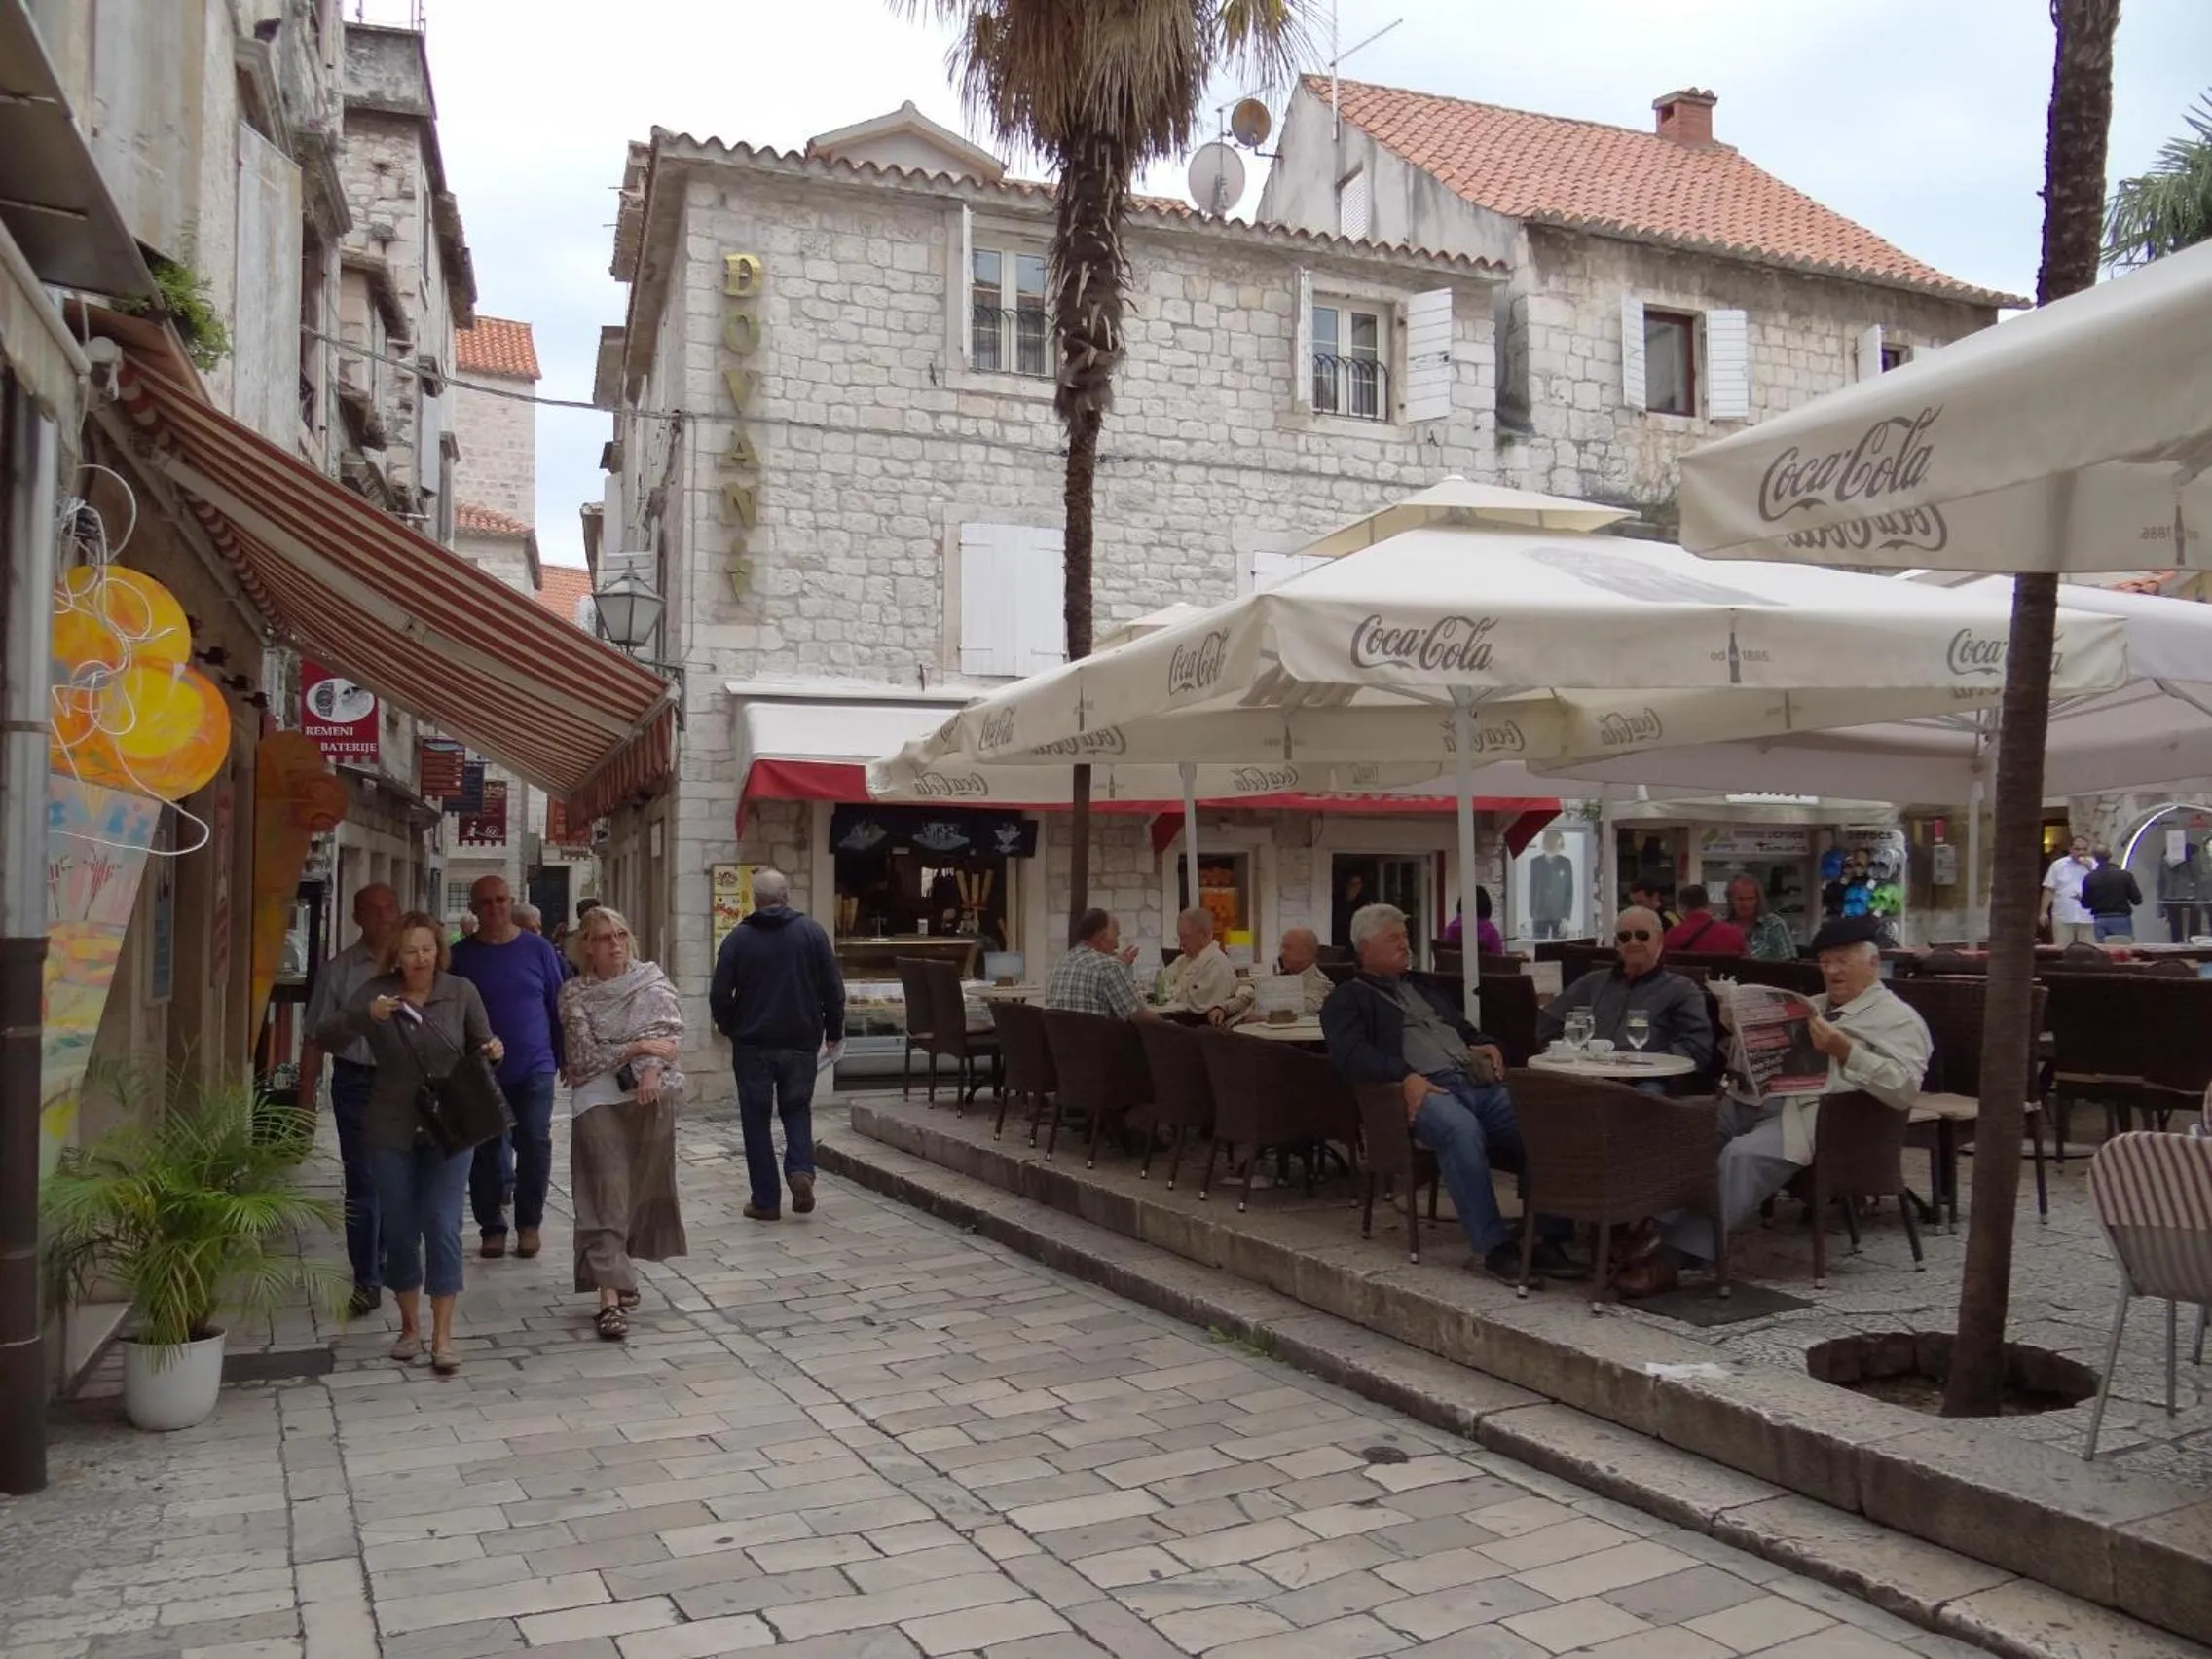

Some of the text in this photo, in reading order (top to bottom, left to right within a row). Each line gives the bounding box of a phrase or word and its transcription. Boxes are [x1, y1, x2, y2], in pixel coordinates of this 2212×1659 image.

[1350, 614, 1500, 671] Coca-Cola
[305, 726, 354, 737] REMENI
[320, 742, 378, 754] BATERIJE
